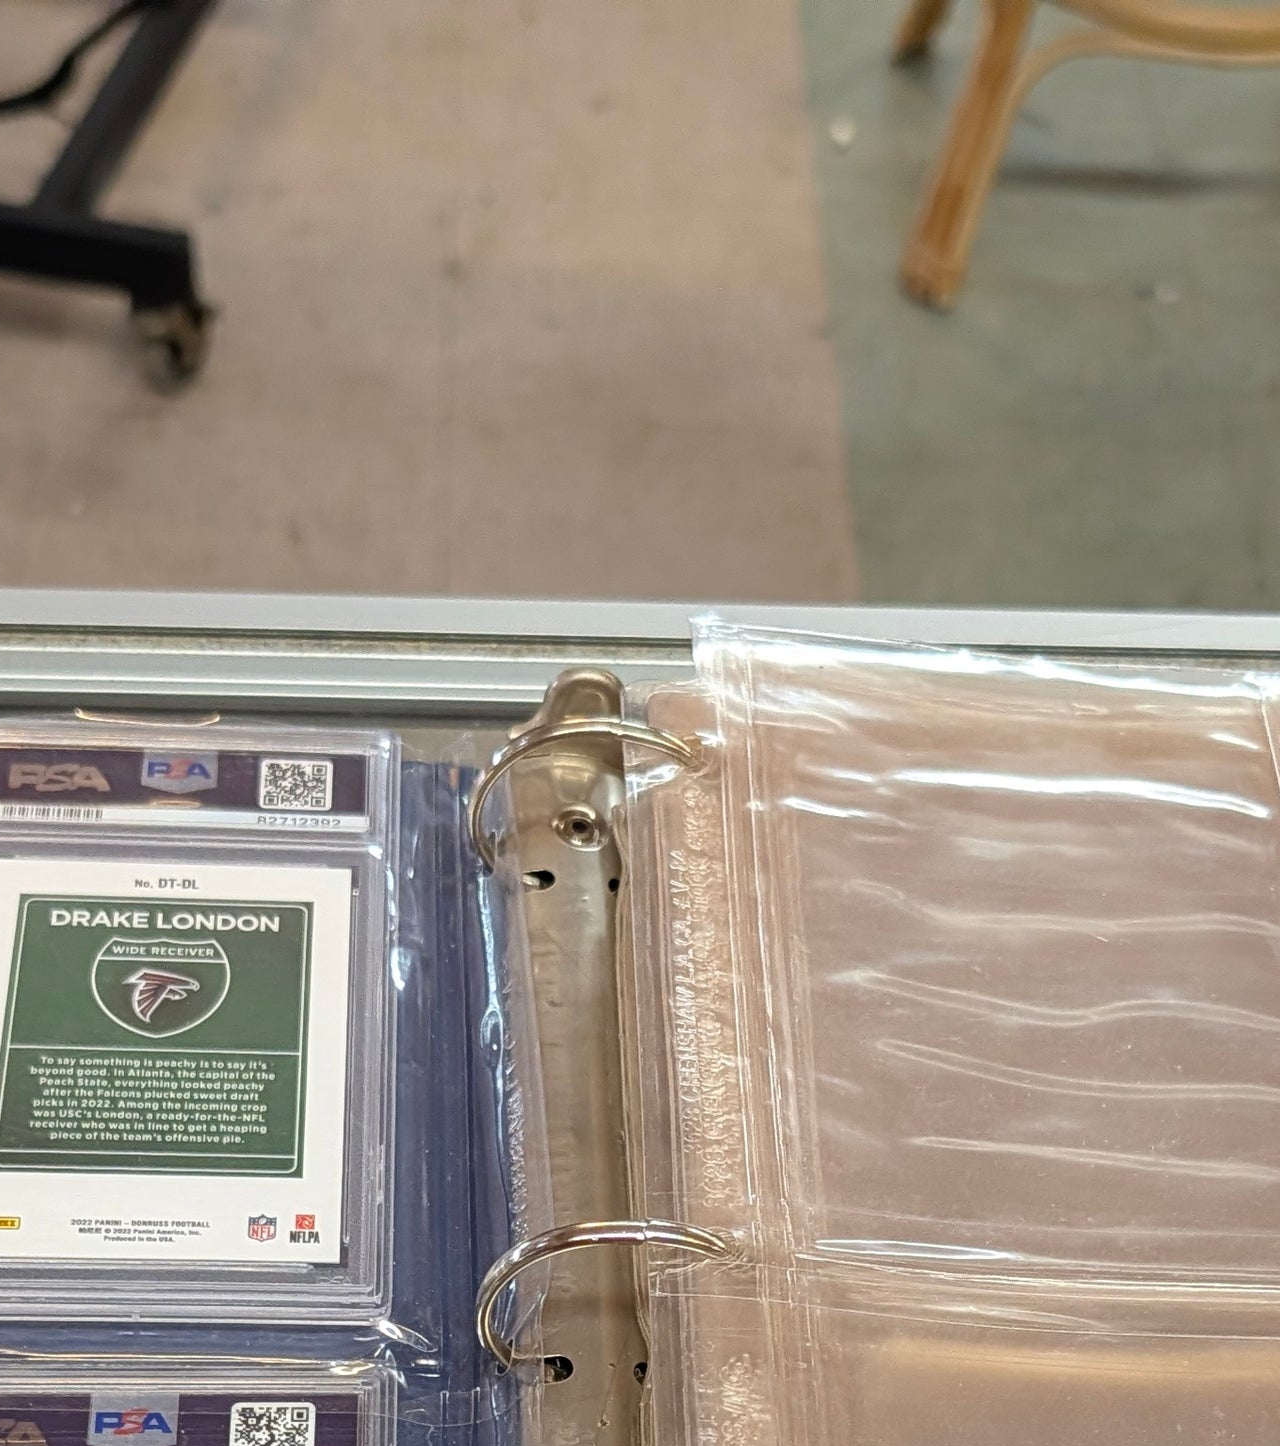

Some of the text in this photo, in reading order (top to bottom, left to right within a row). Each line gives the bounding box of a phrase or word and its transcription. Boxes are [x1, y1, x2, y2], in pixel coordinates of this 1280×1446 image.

[147, 759, 211, 780] PSA
[8, 763, 111, 792] PSA
[135, 879, 199, 890] No. DT-DL
[51, 910, 280, 932] DRAKE LONDON
[112, 944, 214, 957] WIDE RECEIVER
[41, 1056, 267, 1070] To say something is peachy is to say it's
[250, 1227, 276, 1238] NFL
[290, 1232, 320, 1243] NFLPA
[94, 1408, 172, 1436] PSA
